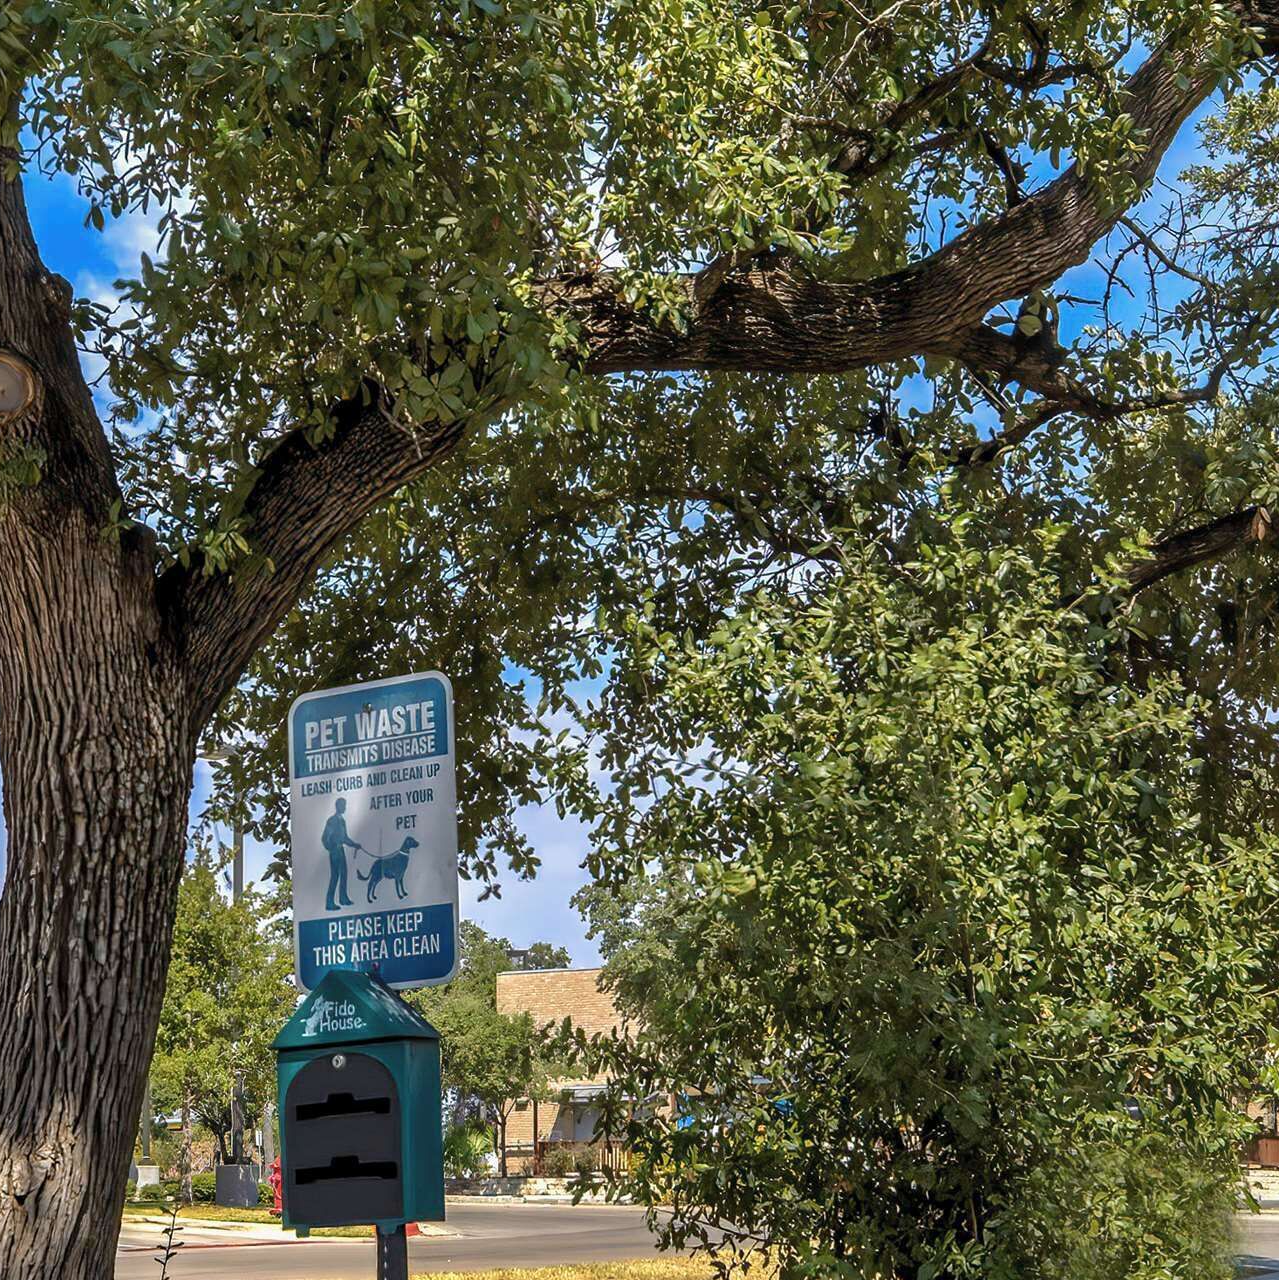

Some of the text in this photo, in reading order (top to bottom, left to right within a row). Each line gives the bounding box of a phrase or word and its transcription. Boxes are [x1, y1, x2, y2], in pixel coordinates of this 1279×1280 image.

[305, 700, 435, 750] PET WASTE
[306, 734, 436, 773] TRANSMITS DISEASE
[301, 763, 441, 797] LEASH CURB AND CLEAN UP
[370, 788, 434, 810] AFTER YOUR
[395, 814, 417, 830] PET
[328, 911, 424, 941] PLEASE KEEP
[312, 933, 440, 967] THIS AREA CLEAN
[325, 999, 356, 1018] Fido
[320, 1016, 363, 1033] House
